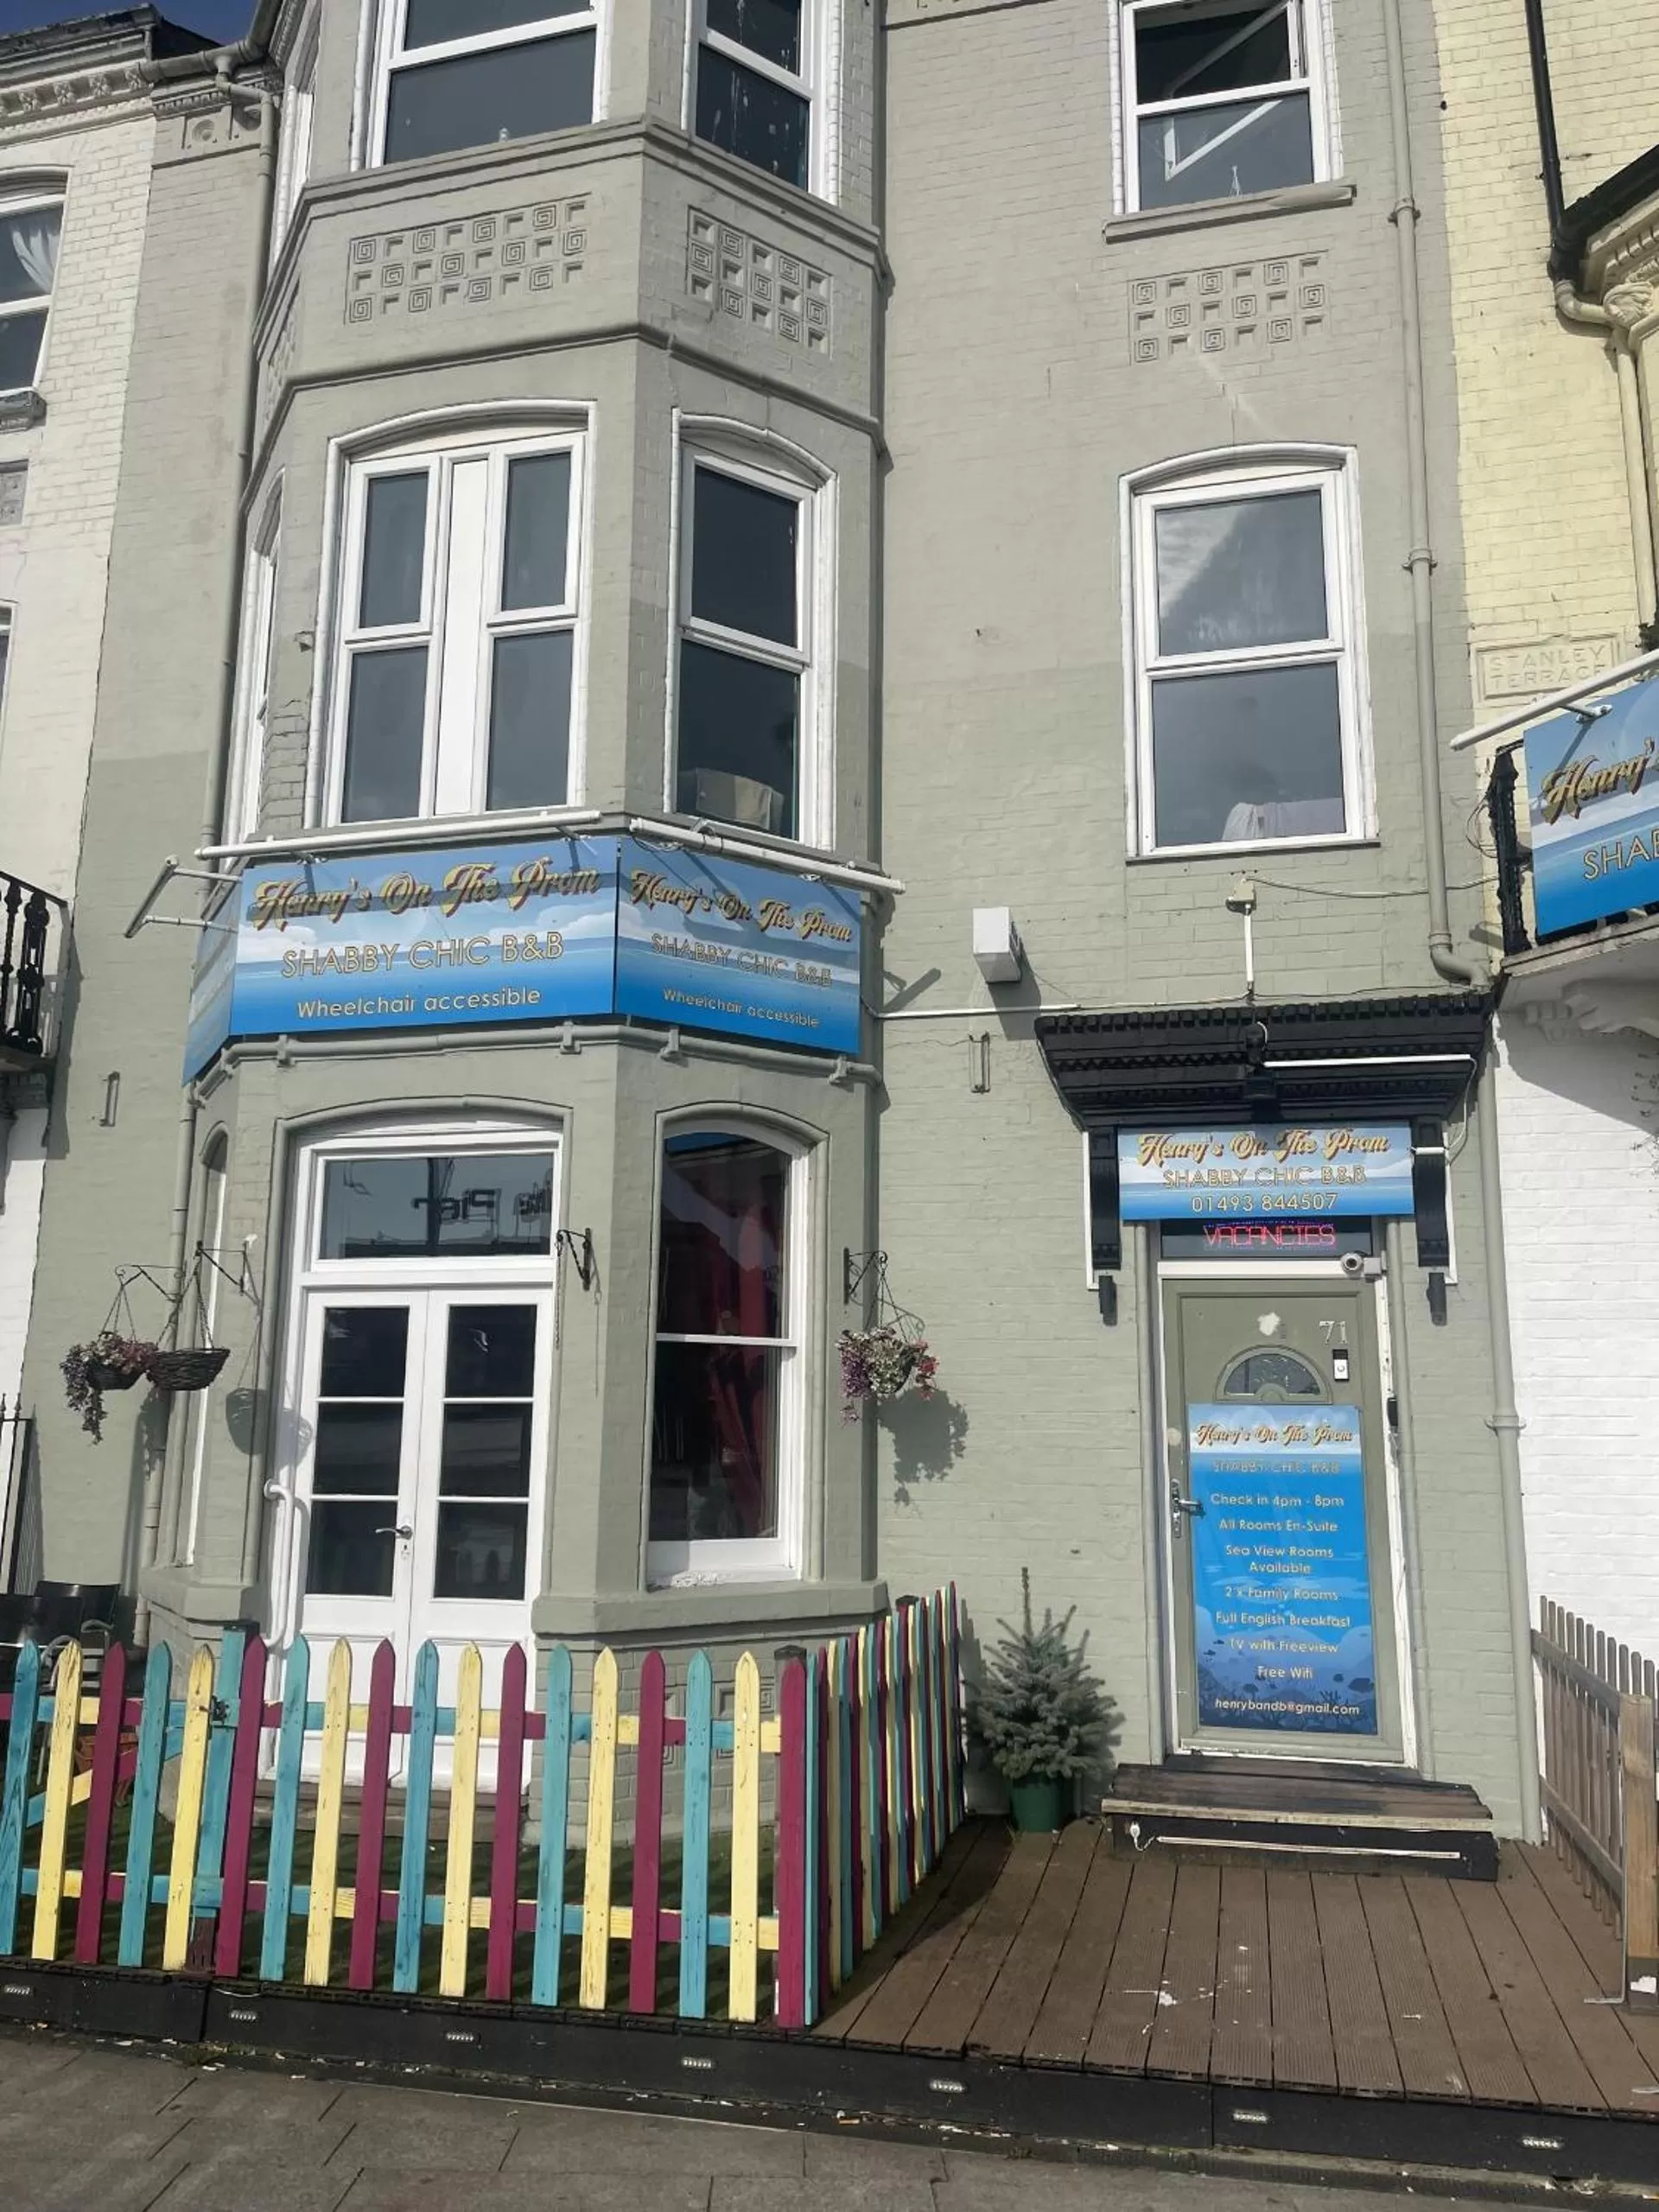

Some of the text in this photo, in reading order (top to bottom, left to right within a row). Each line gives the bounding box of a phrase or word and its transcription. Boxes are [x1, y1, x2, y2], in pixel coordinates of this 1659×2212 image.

[1490, 645, 1605, 671] STANLEY
[1490, 664, 1605, 690] TERRACE
[1541, 737, 1659, 825] Henry'
[251, 855, 602, 932] Henry's On The Prom
[630, 867, 853, 942] Henry's On The Prom
[281, 931, 563, 978] SHABBY CHIC B&B
[651, 933, 833, 988] SHABBY CHIC B&B
[297, 985, 541, 1018] Wheelchair accessible
[664, 987, 820, 1028] Wheelchair accessible
[1136, 1128, 1390, 1167] Henry's On The Prom
[1163, 1165, 1366, 1188] SHABBY CHIC B&B
[1192, 1192, 1338, 1212] 01493 844507
[1204, 1224, 1337, 1247] VACANCIES
[1319, 1320, 1347, 1344] 71
[1196, 1425, 1250, 1446] Henry's
[1255, 1425, 1278, 1442] On
[1282, 1425, 1308, 1446] The
[1211, 1493, 1253, 1504] Check
[1257, 1493, 1268, 1504] in
[1273, 1495, 1301, 1508] 4pm
[1314, 1495, 1344, 1508] 8pm
[1219, 1519, 1338, 1531] All Rooms En-Suite
[1226, 1545, 1334, 1558] Sea View Rooms
[1249, 1561, 1312, 1573] Available
[1224, 1586, 1232, 1597] 2
[1248, 1587, 1287, 1600] Family
[1294, 1589, 1338, 1600] Rooms
[1216, 1611, 1350, 1628] Full English Breakfast
[1230, 1638, 1339, 1652] TV with Freeview
[1257, 1666, 1313, 1679] Free Wifi
